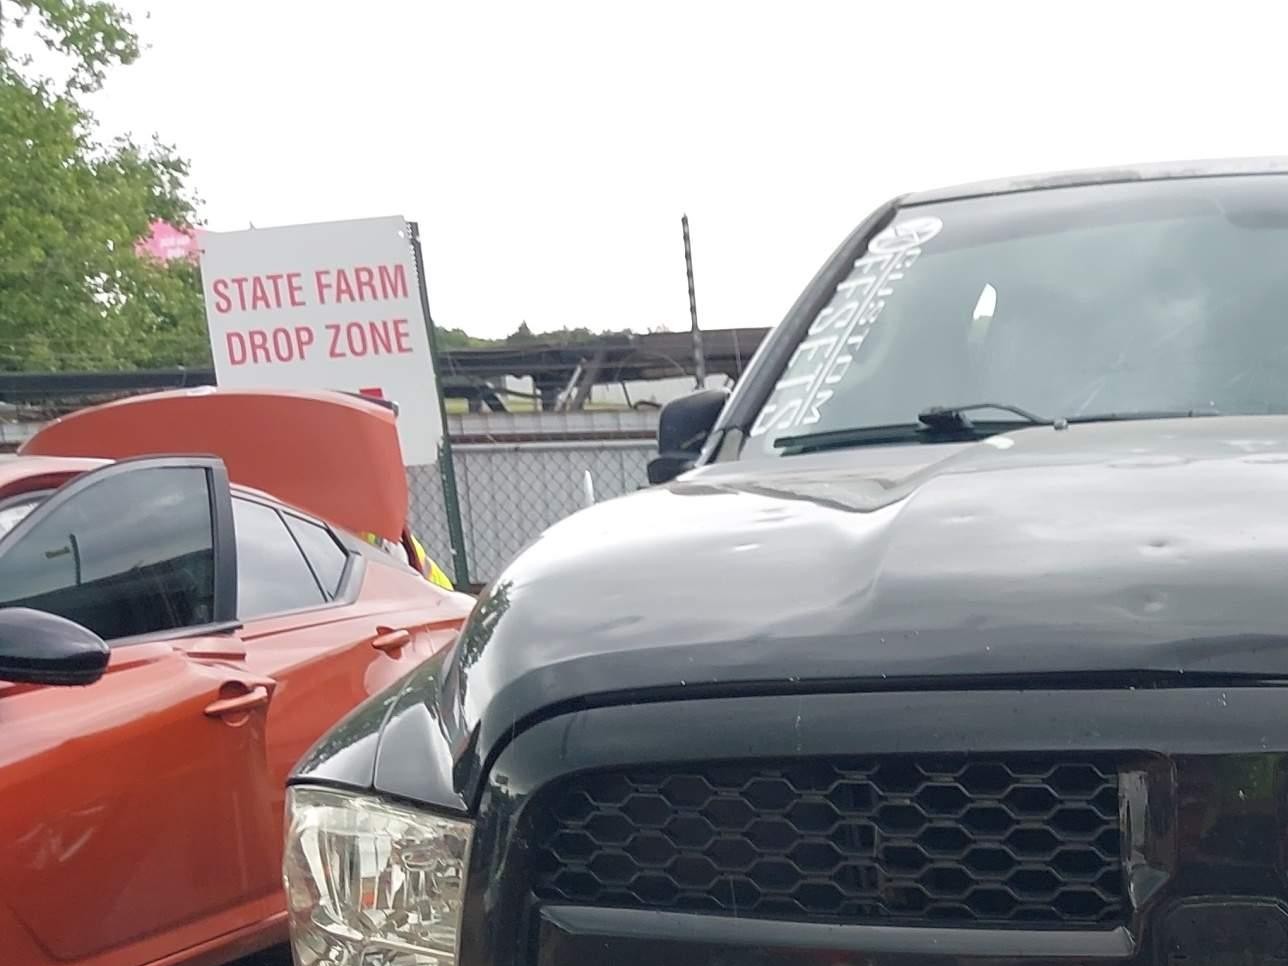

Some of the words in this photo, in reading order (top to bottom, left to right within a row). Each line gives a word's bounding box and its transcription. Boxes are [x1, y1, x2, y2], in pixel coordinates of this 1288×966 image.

[212, 272, 305, 315] STATE
[314, 264, 408, 304] FARM
[225, 325, 315, 367] DROP
[325, 318, 413, 359] ZONE
